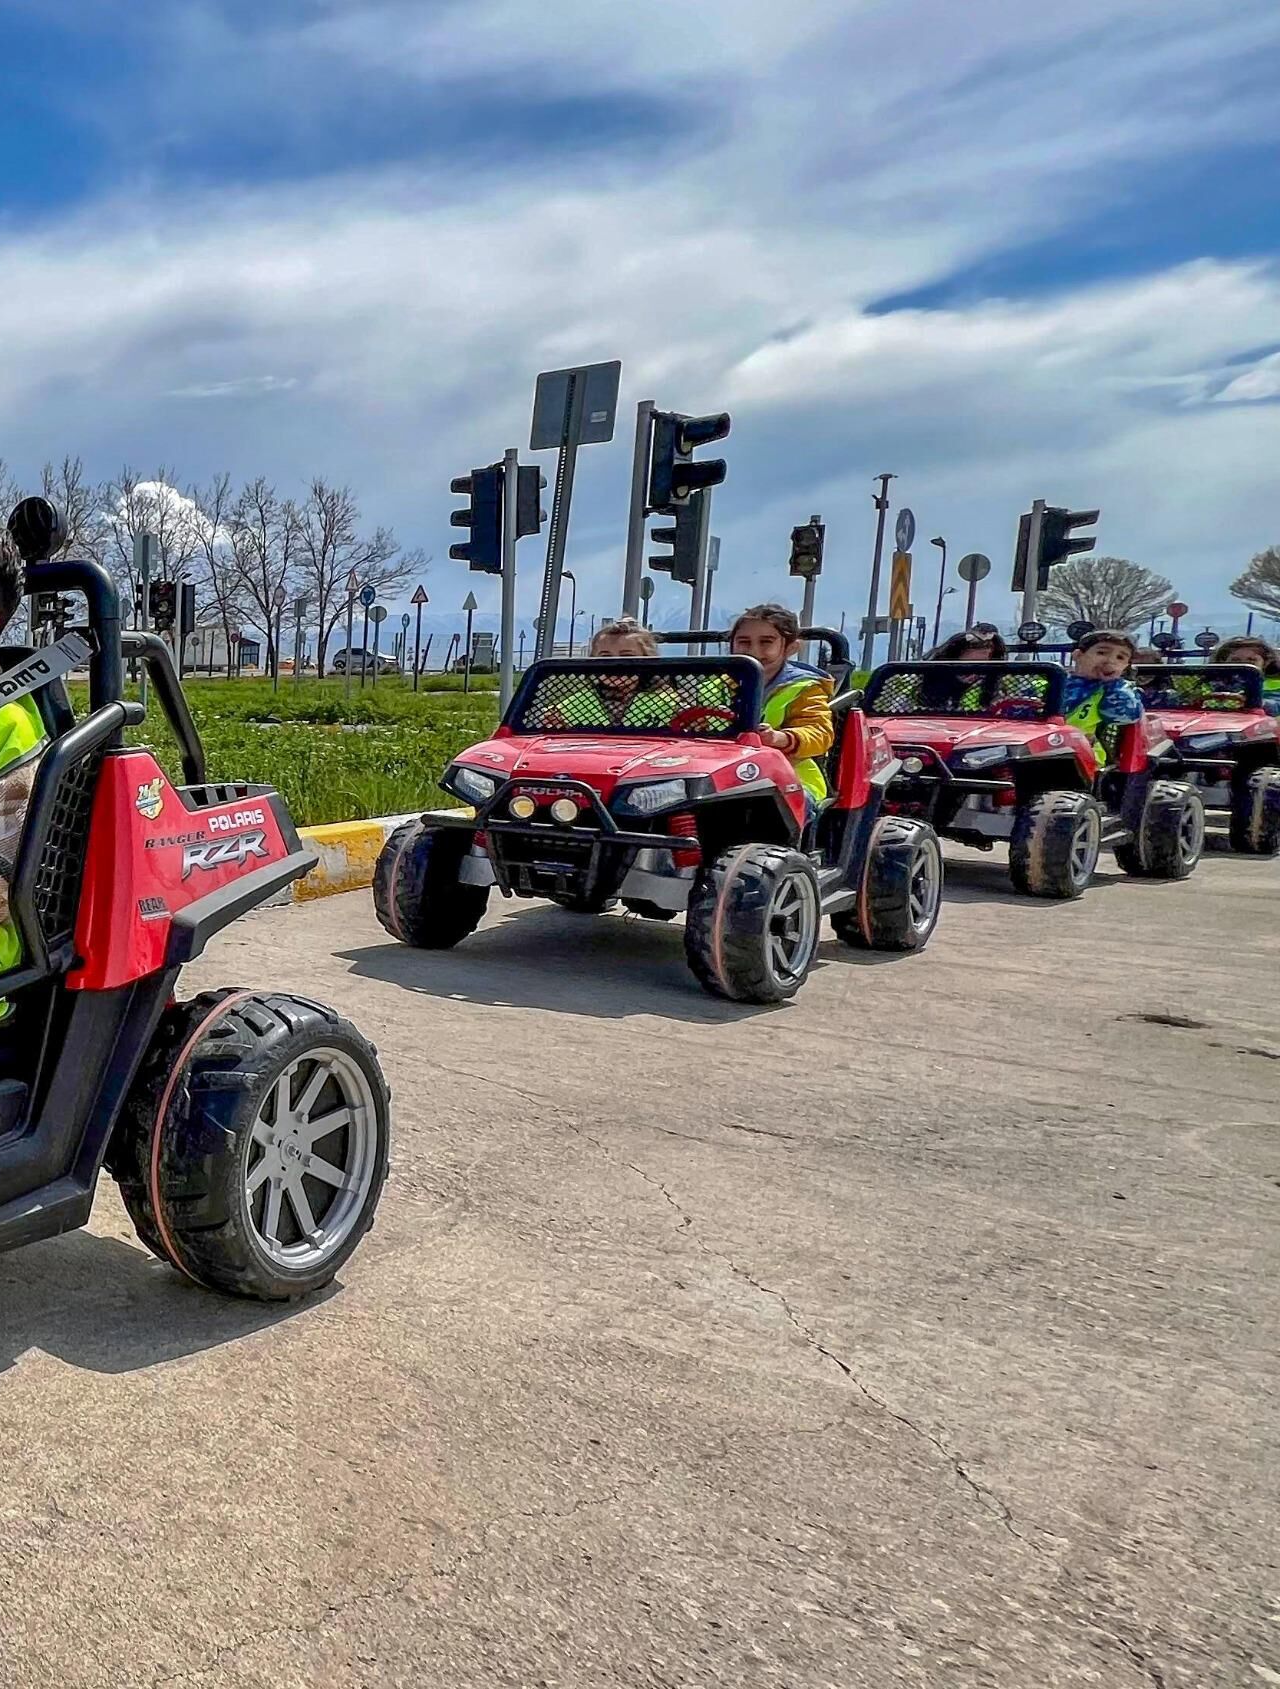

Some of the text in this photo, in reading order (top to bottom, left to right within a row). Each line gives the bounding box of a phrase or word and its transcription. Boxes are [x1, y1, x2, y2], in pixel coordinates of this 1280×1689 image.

[208, 808, 265, 833] POLARIS
[144, 831, 207, 850] RANGER
[181, 829, 270, 881] RZR
[138, 896, 166, 913] REAR
